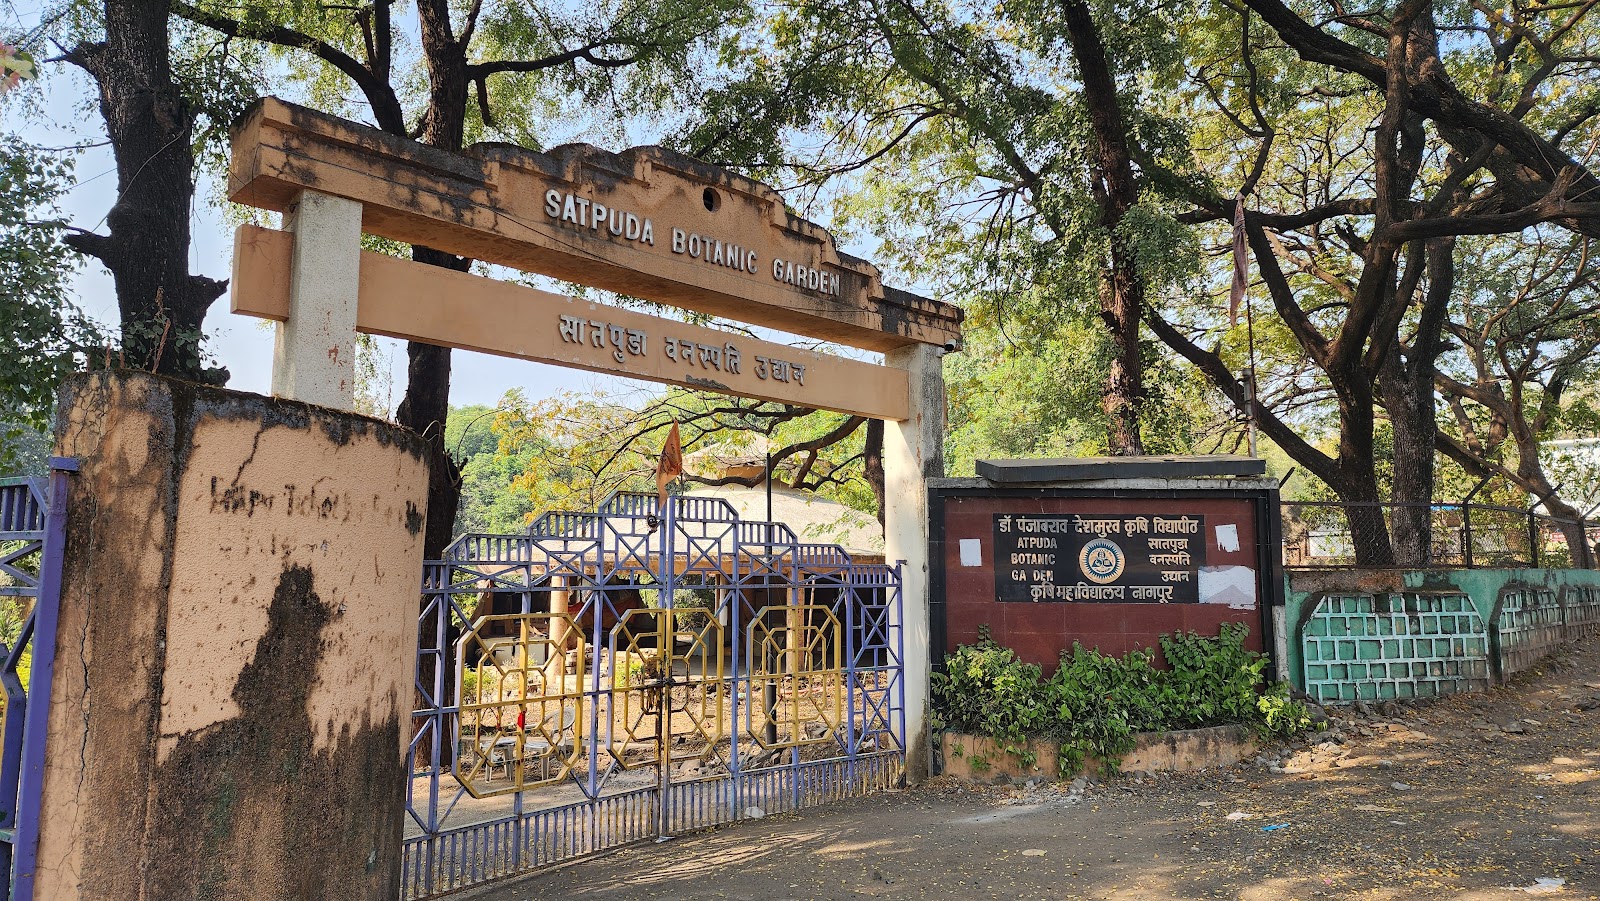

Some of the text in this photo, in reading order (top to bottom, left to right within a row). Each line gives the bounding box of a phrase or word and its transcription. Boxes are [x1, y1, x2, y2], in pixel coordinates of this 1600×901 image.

[544, 188, 841, 297] SATPUDA BOTANIC GARDEN
[558, 313, 807, 387] सातपुडा वनस्पति उद्यान
[1016, 515, 1068, 534] पंजाबराव
[1072, 514, 1121, 538] देशमुख
[1124, 516, 1149, 537] कृषि
[1152, 515, 1199, 534] विद्यापीठ
[1147, 538, 1189, 552] सातपुडा
[1011, 553, 1056, 565] BOTANIC
[1149, 551, 1191, 566] वनस्पति
[1160, 570, 1190, 582] उद्यान
[1129, 586, 1174, 603] नागपूर
